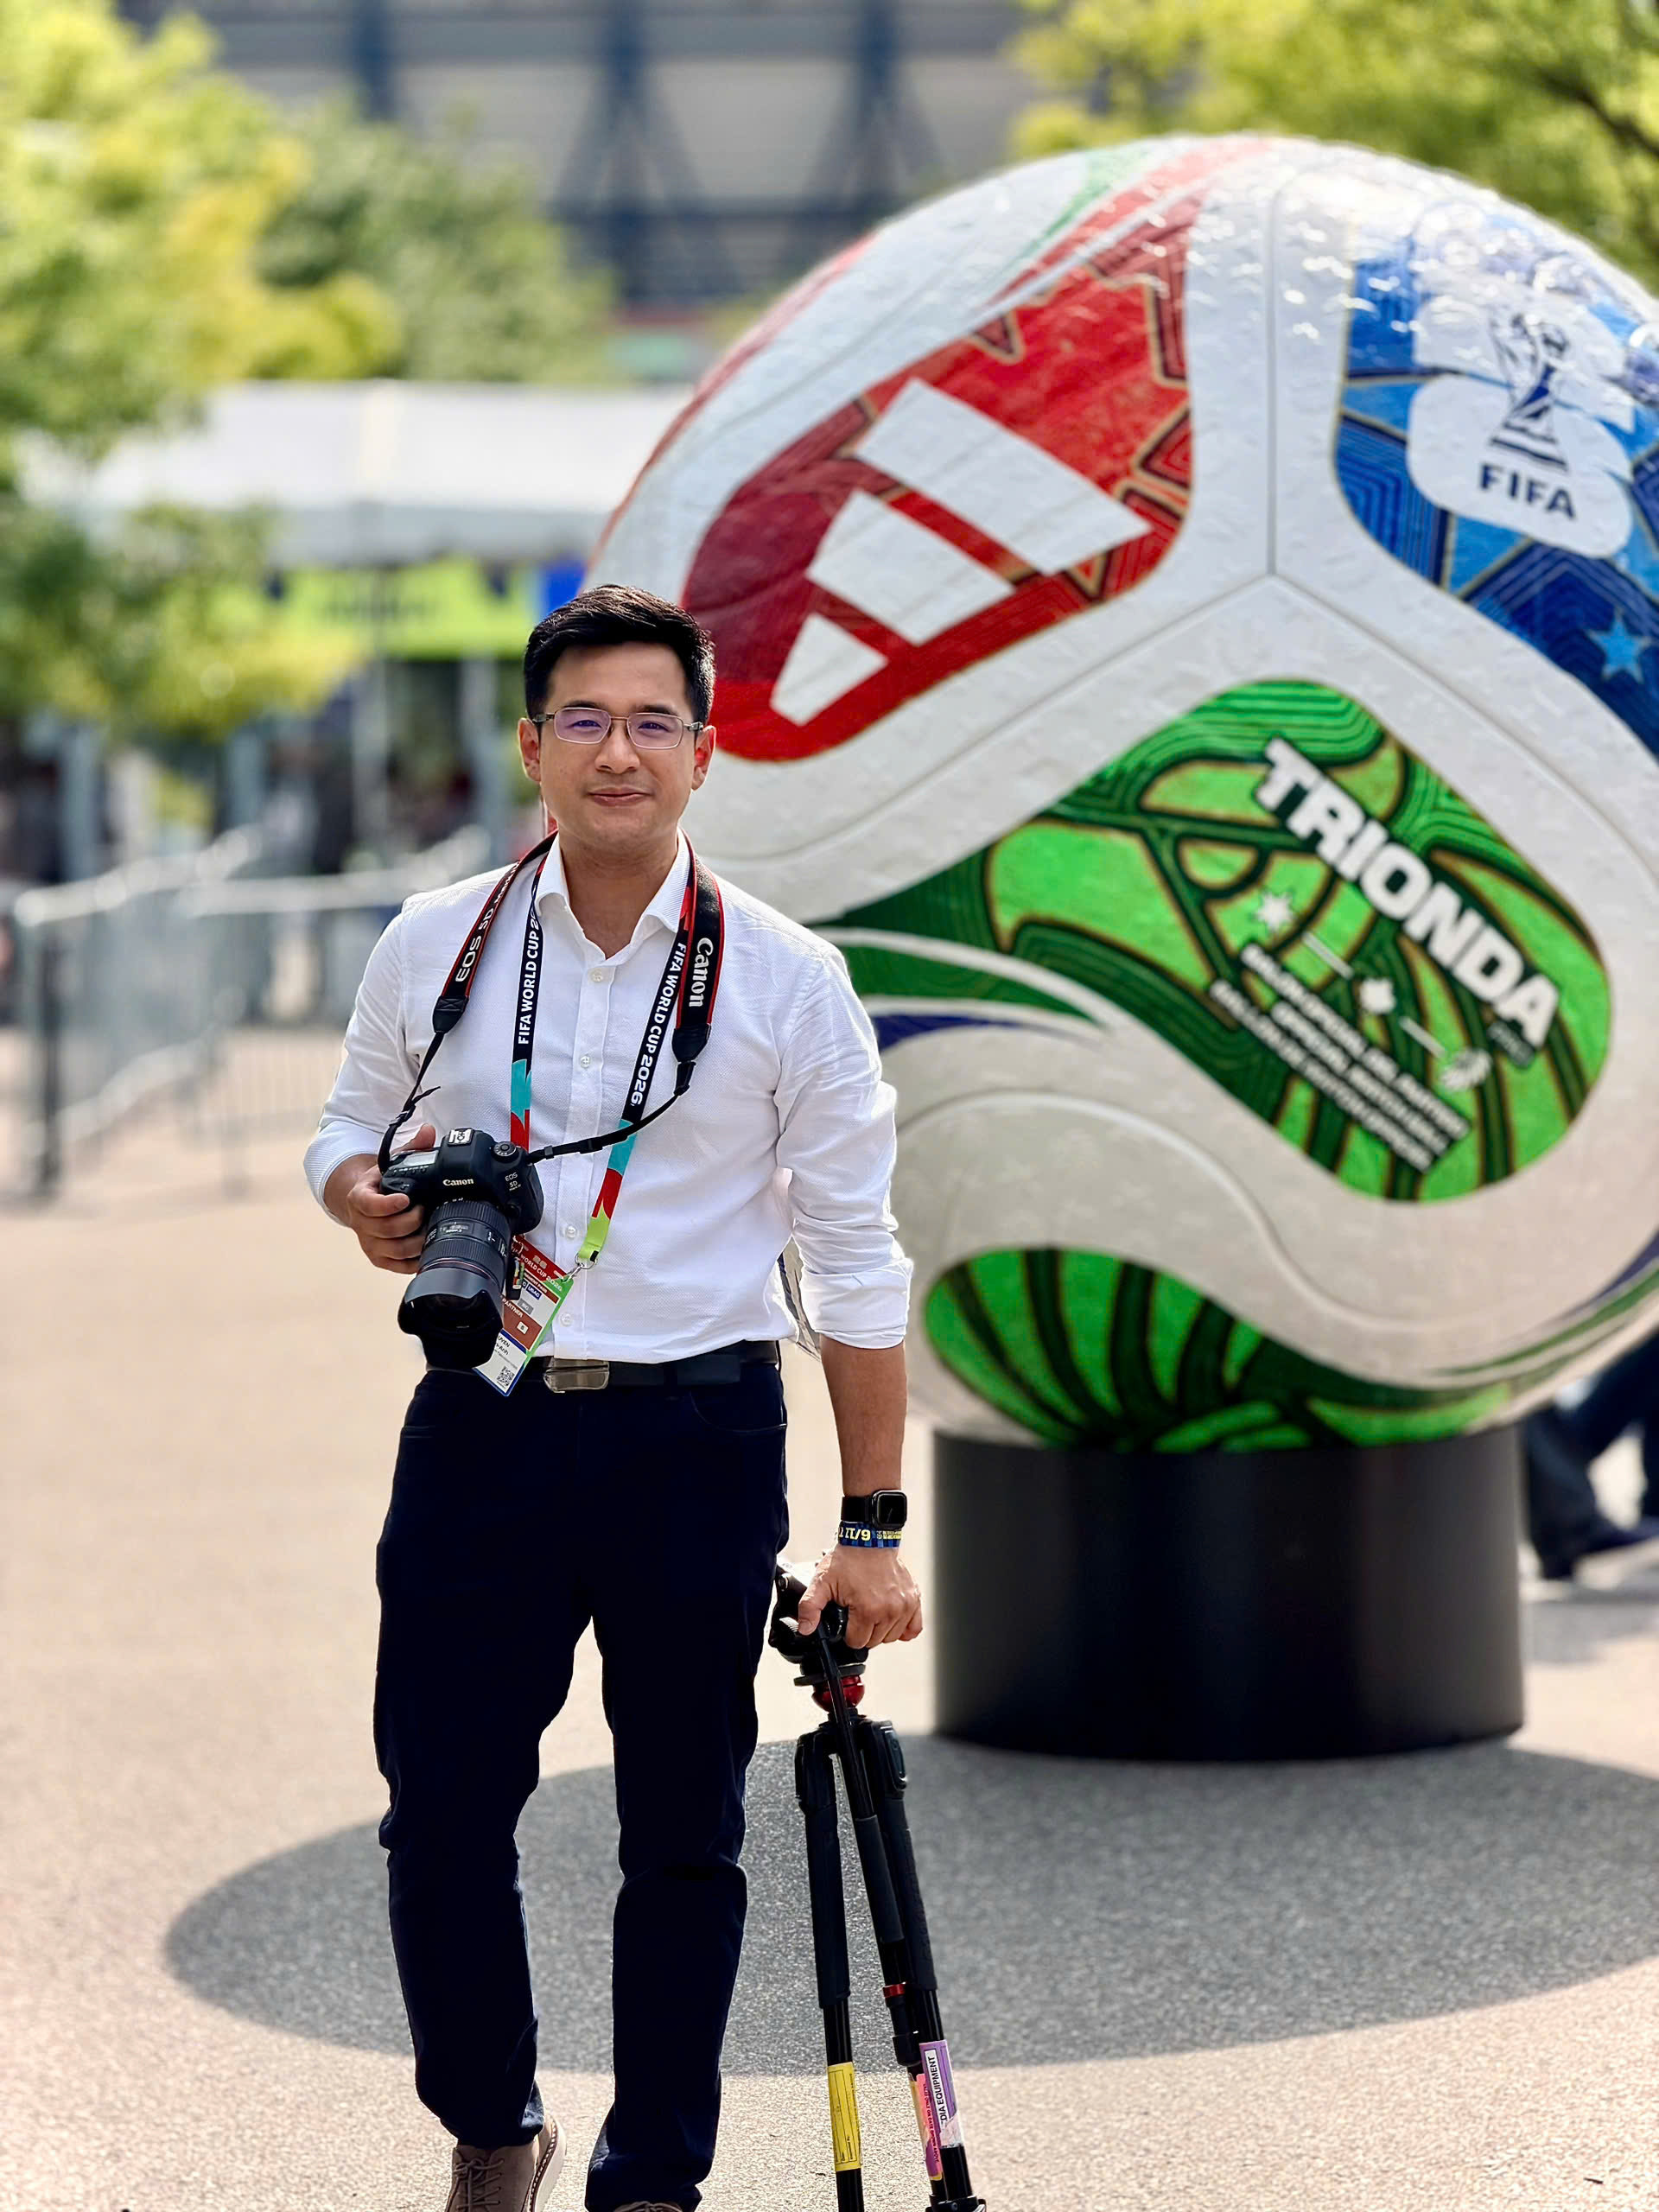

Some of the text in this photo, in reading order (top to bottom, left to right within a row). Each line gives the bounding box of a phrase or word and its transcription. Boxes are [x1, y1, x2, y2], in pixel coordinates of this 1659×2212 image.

[1478, 461, 1577, 522] FIFA
[1255, 736, 1560, 1049] TRIONDA
[454, 935, 482, 982] EOS
[526, 930, 540, 957] CUP
[669, 943, 687, 973] FIFA
[521, 961, 537, 1013] WORLD
[688, 937, 715, 1007] Canon
[654, 974, 679, 1025] WORLD
[518, 1014, 532, 1045] FIFA
[645, 1025, 663, 1054] CUP
[442, 1178, 474, 1186] Canon
[505, 1172, 518, 1182] EOS
[520, 1254, 537, 1270] WORLD
[537, 1268, 548, 1278] CUP
[501, 1297, 524, 1318] PARTNER
[928, 2056, 948, 2122] DIA EQUIPMENT
